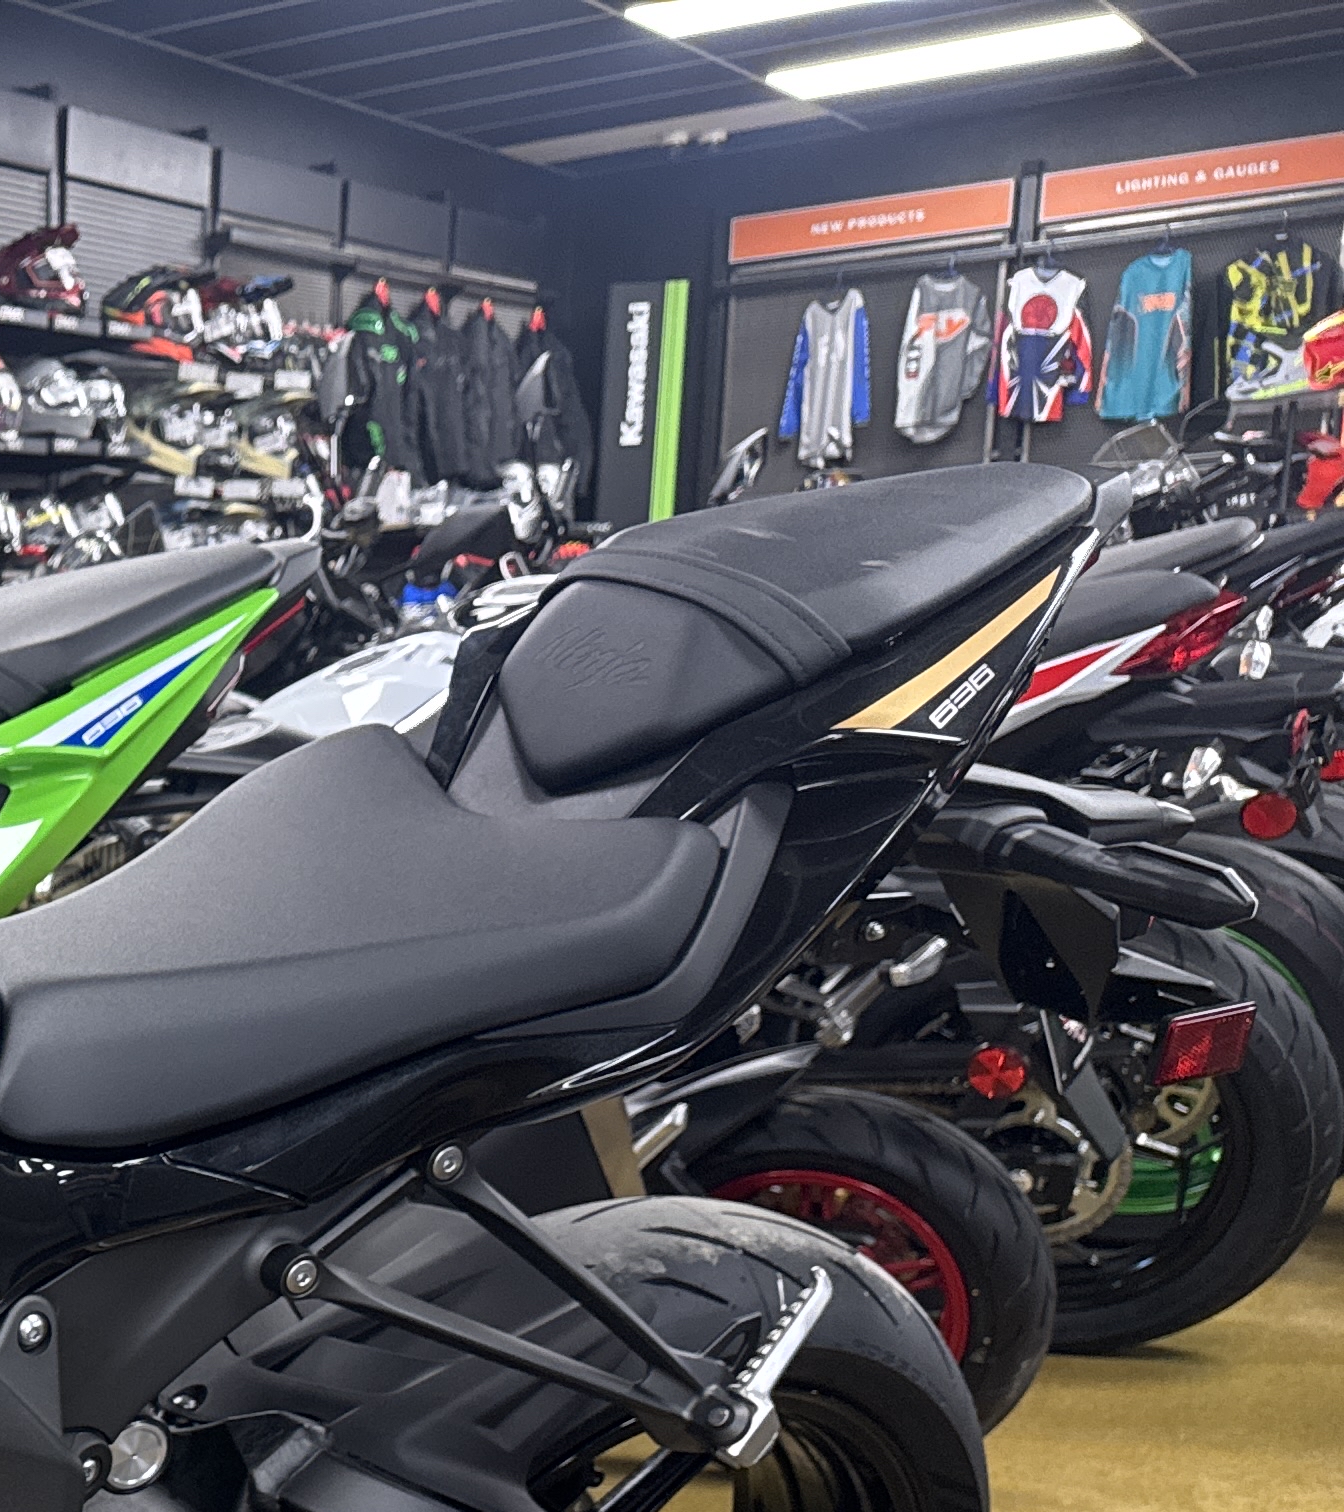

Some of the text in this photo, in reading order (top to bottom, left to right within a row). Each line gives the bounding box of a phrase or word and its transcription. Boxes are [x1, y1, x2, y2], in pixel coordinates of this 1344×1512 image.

[1115, 171, 1190, 195] LIGHTING
[810, 208, 927, 236] NEW PRODUCTS
[618, 301, 652, 446] Kawasaki
[928, 662, 996, 730] 636
